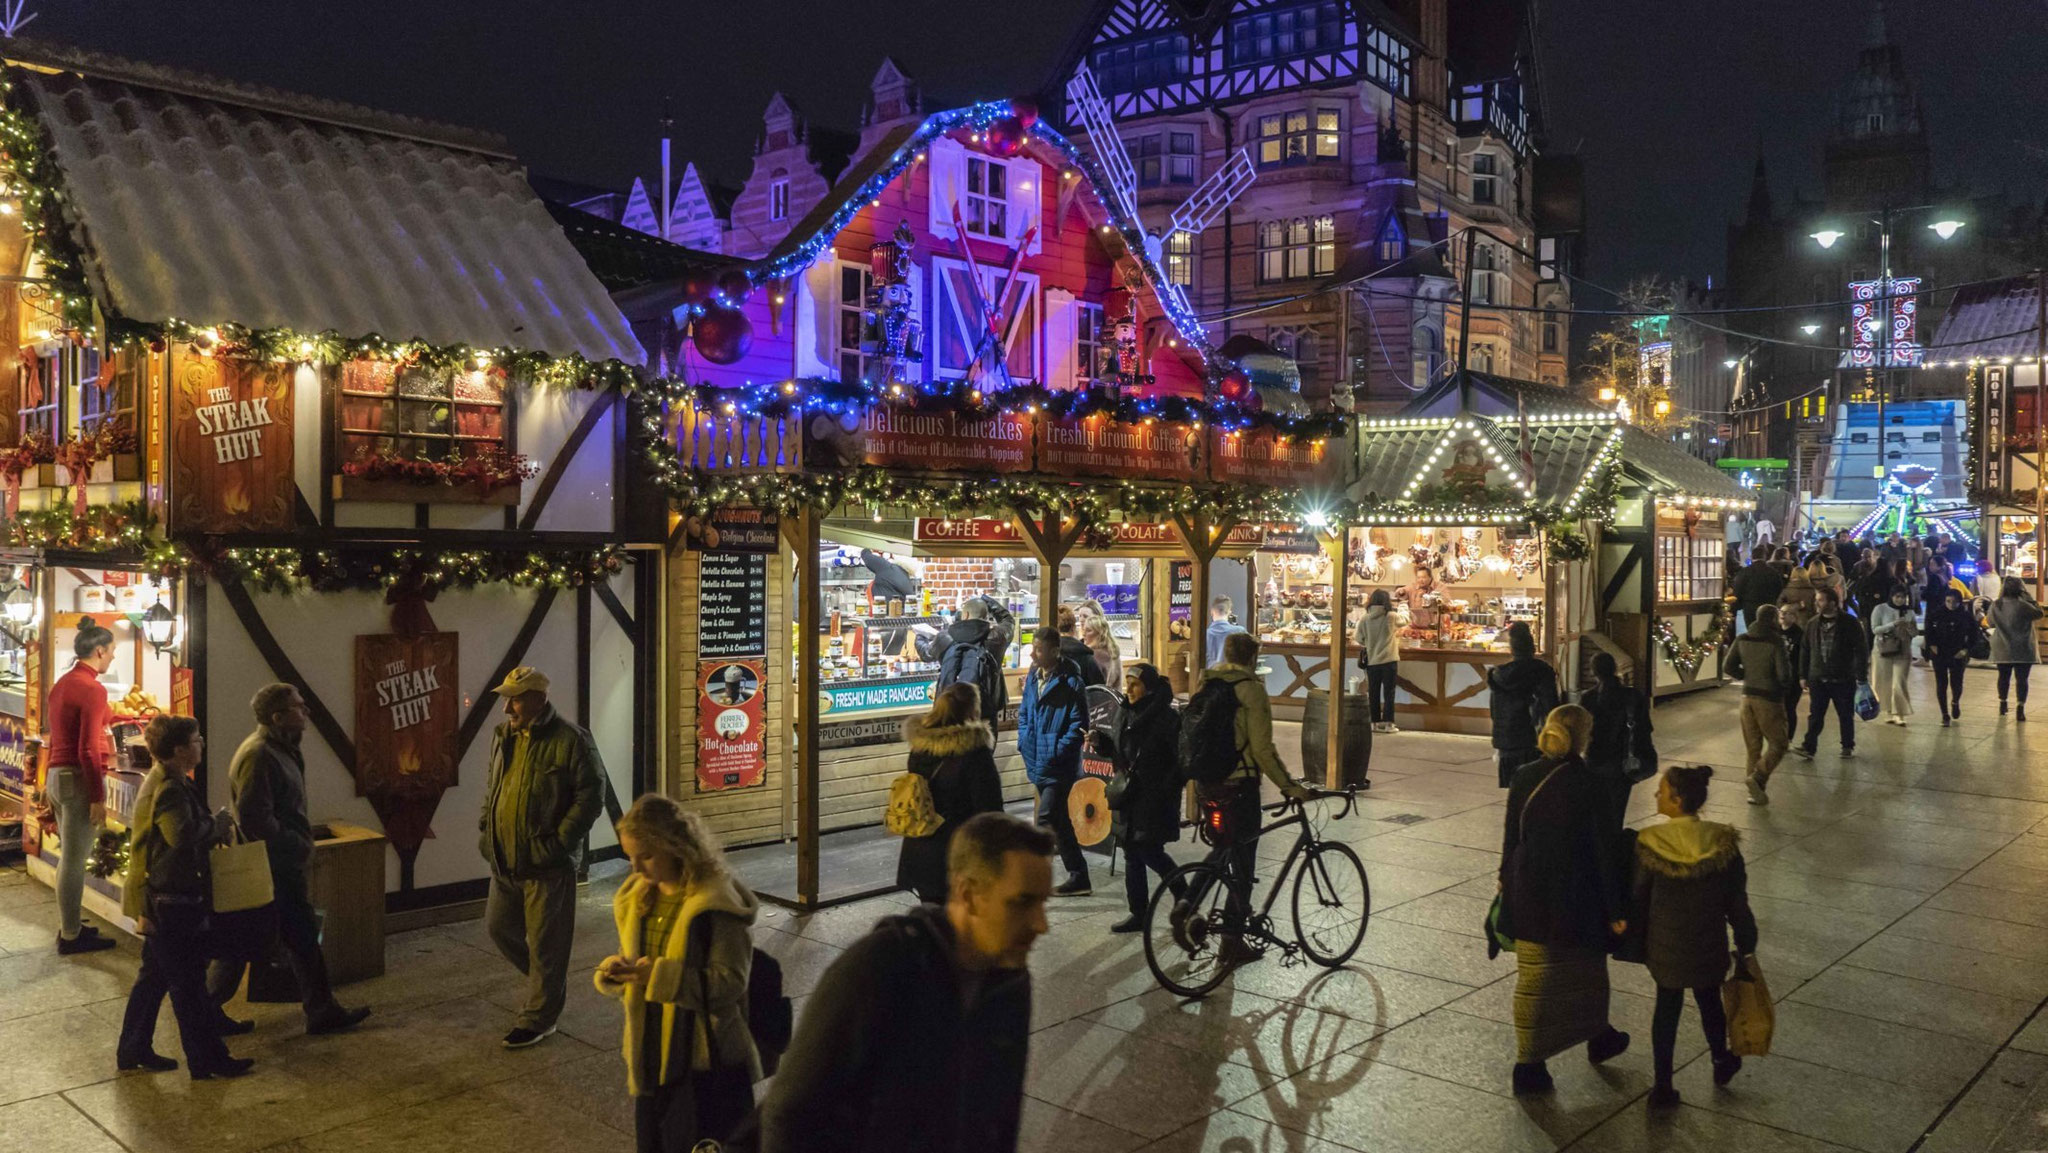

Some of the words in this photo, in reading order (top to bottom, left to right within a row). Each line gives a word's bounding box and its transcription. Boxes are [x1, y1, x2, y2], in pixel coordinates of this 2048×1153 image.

[1990, 372, 2000, 398] HOT
[207, 386, 232, 403] THE
[195, 397, 273, 435] STEAK
[864, 404, 945, 436] Delicious
[950, 410, 1023, 441] Pancakes
[1047, 421, 1095, 452] Freshly
[1100, 425, 1143, 450] Ground
[1146, 429, 1181, 452] Coffee
[1989, 408, 2000, 452] ROAST
[213, 429, 262, 463] HUT
[865, 438, 886, 454] With
[898, 440, 928, 455] Choice
[942, 442, 987, 458] Delectable
[989, 445, 1023, 463] Toppings
[1221, 436, 1237, 458] Hot
[1241, 438, 1267, 461] Fresh
[1271, 441, 1320, 469] Doughnuts
[1988, 461, 1998, 488] HAM
[746, 530, 775, 544] Chocolate
[925, 521, 980, 537] COFFEE
[702, 554, 719, 562] Lemon
[725, 554, 739, 564] Sugar
[721, 567, 744, 575] Chocolate
[701, 593, 717, 602] Maple
[718, 593, 732, 602] Syrup
[726, 605, 741, 614] Cream
[719, 618, 735, 627] Cheese
[701, 632, 717, 640] Cheese
[723, 631, 746, 641] Pineapple
[735, 643, 750, 652] Cream
[385, 659, 407, 676] THE
[376, 665, 440, 706] STEAK
[835, 691, 865, 708] FRESHLY
[867, 689, 888, 705] MADE
[889, 685, 925, 703] PANCAKES
[390, 695, 431, 730] HUT
[720, 721, 745, 729] ROCHER
[872, 722, 896, 734] LATTE
[705, 738, 719, 750] Hot
[719, 740, 758, 755] Chocolate
